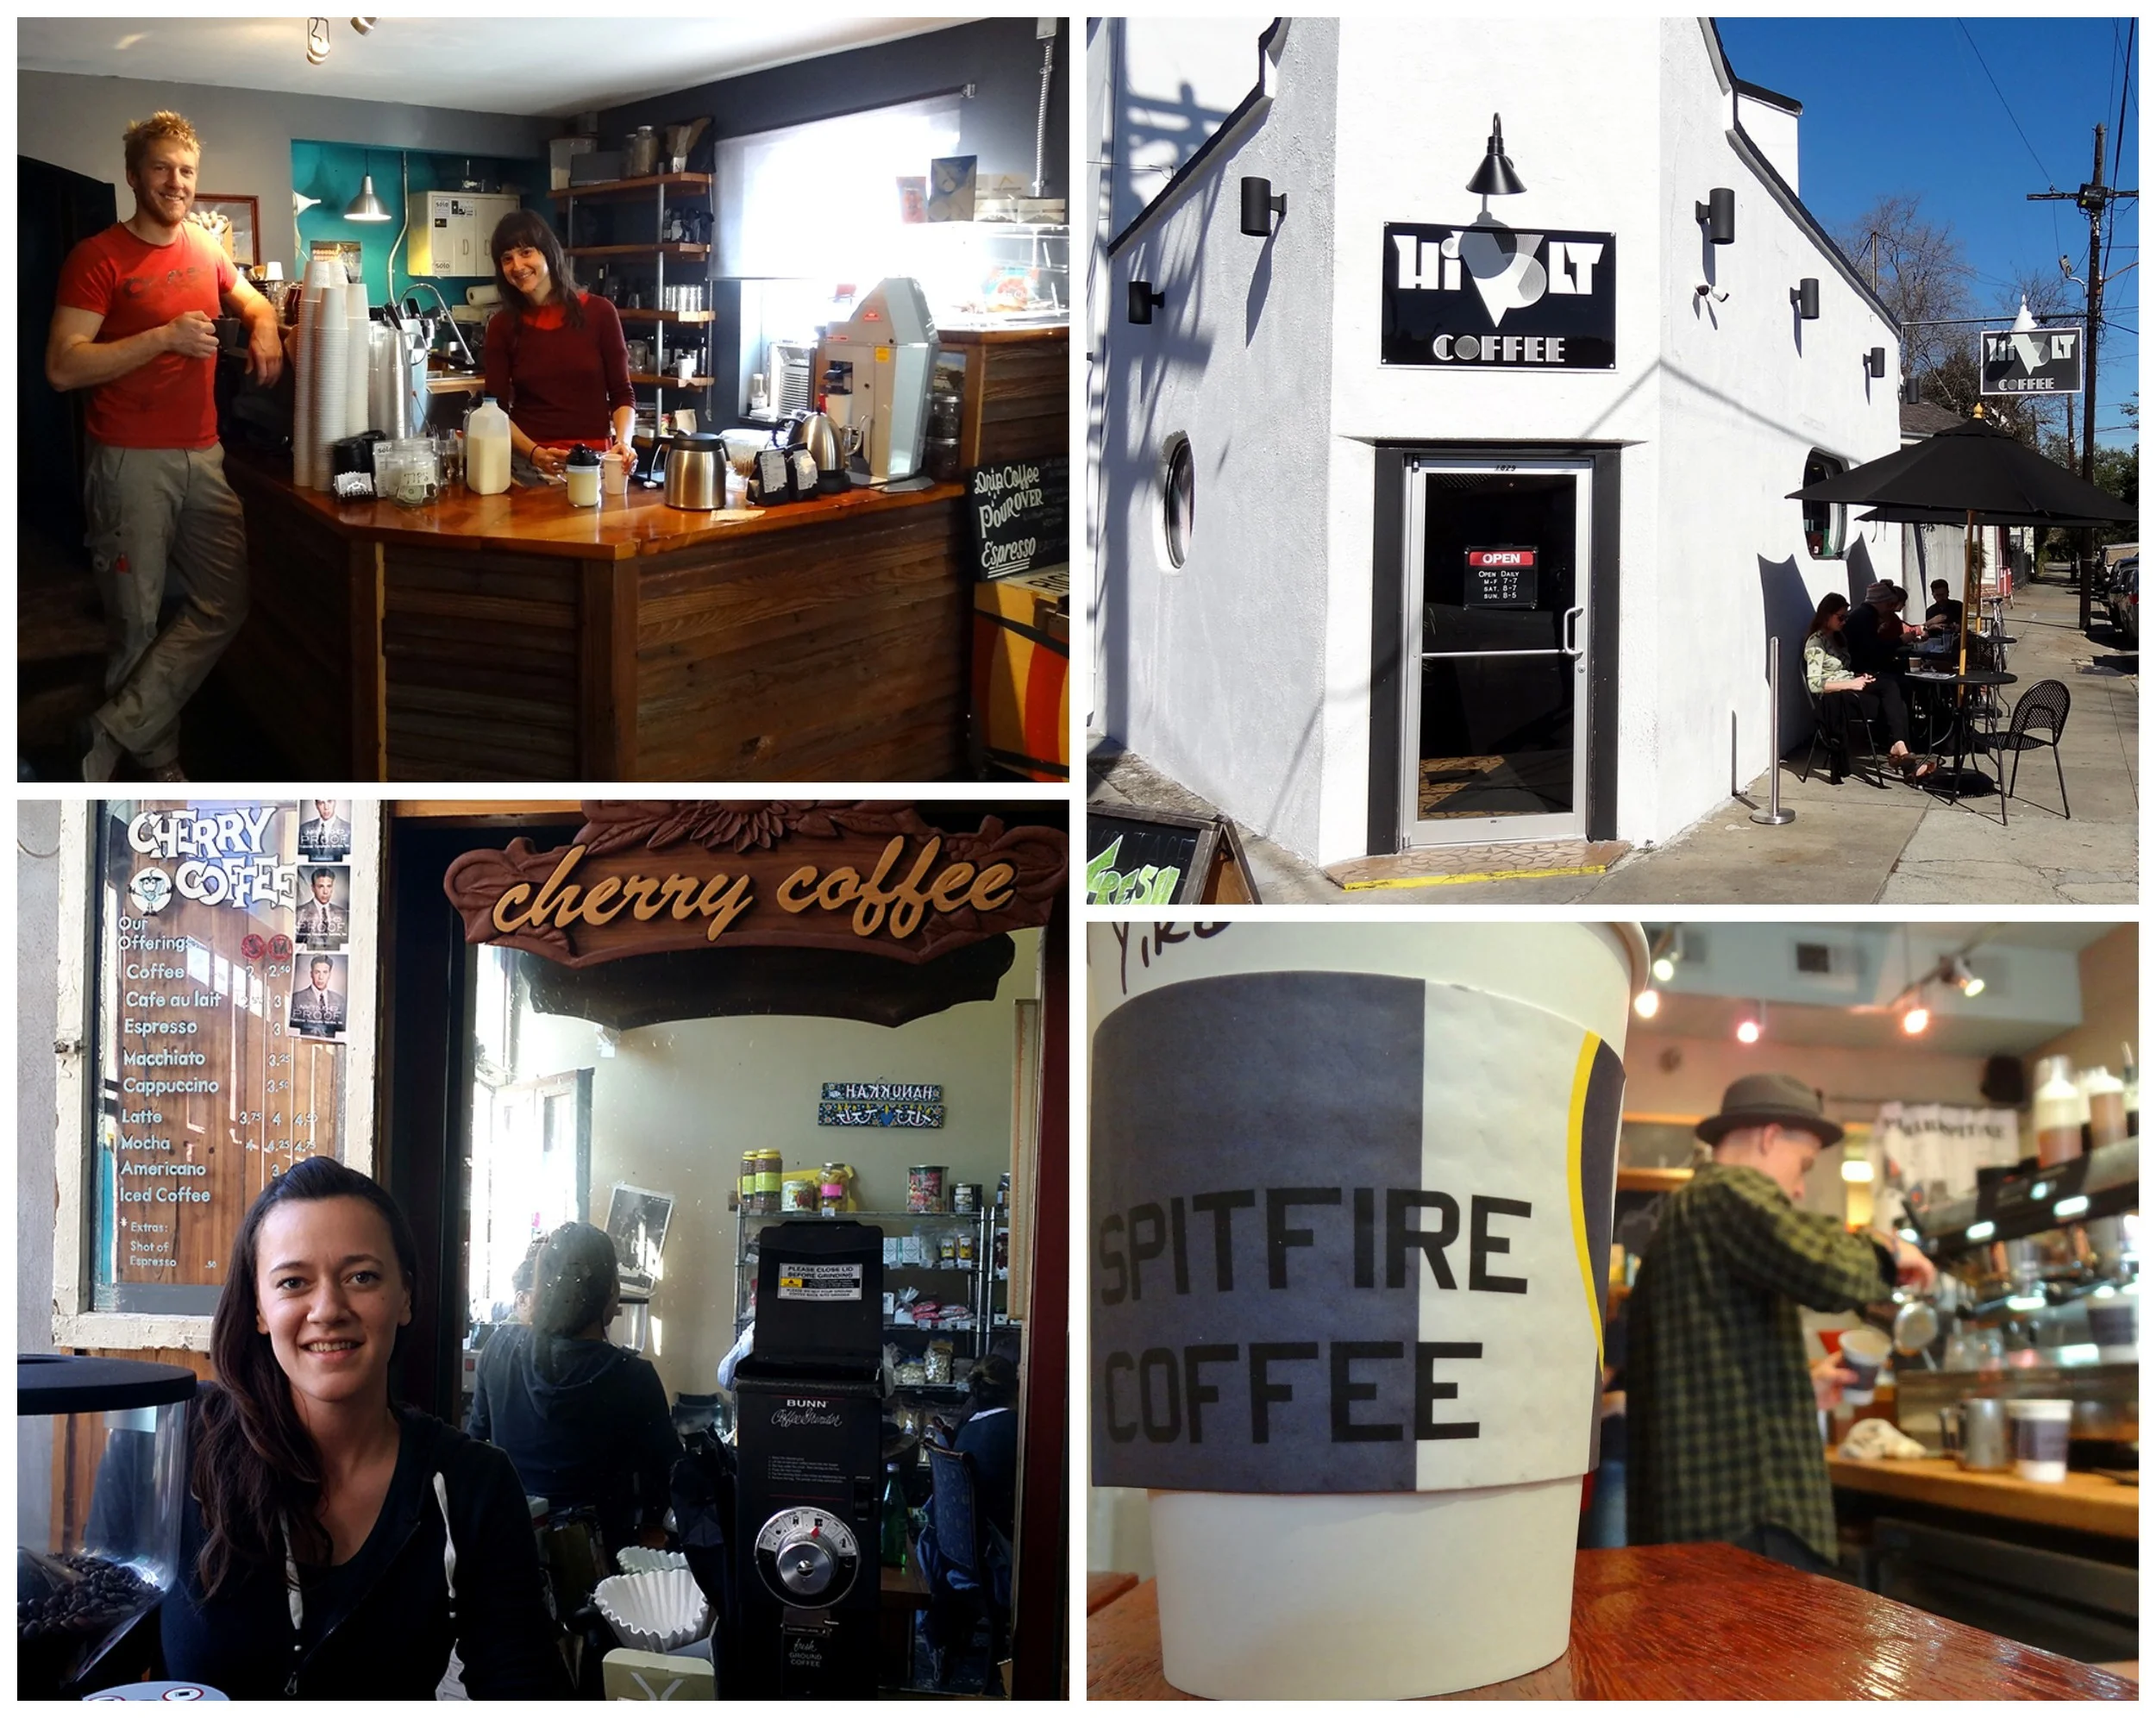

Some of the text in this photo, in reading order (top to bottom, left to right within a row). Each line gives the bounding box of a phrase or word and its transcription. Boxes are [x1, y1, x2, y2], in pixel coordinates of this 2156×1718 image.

[1432, 334, 1565, 362] COFFEE
[1998, 377, 2055, 391] COFFEE
[975, 467, 1004, 495] Drip
[1003, 464, 1041, 490] Coffee
[981, 536, 1037, 568] Espresso
[1482, 554, 1521, 564] OPEN
[128, 806, 278, 859] CHERRY
[175, 855, 295, 912] COFFEE
[491, 835, 1017, 942] cherry coffee
[118, 915, 148, 931] Our
[118, 934, 191, 953] Offerings
[127, 962, 185, 980] Coffee
[126, 991, 166, 1007] Cafe
[170, 995, 190, 1007] au
[194, 989, 222, 1007] lait
[292, 1008, 342, 1020] PROOF
[124, 1018, 197, 1038] Espresso
[123, 1048, 206, 1066] Macchiato
[123, 1077, 219, 1097] Cappuccino
[122, 1109, 162, 1124] Latte
[272, 1111, 281, 1126] 4
[121, 1134, 171, 1151] Mocha
[121, 1163, 206, 1176] Americano
[120, 1188, 210, 1202] Iced Coffee
[131, 1221, 168, 1233] Extras:
[130, 1240, 170, 1252] Shot of
[1099, 1187, 1532, 1306] SPITFIRE
[129, 1255, 177, 1270] Espresso
[1104, 1340, 1483, 1445] COFFEE
[787, 1399, 827, 1408] BUNN
